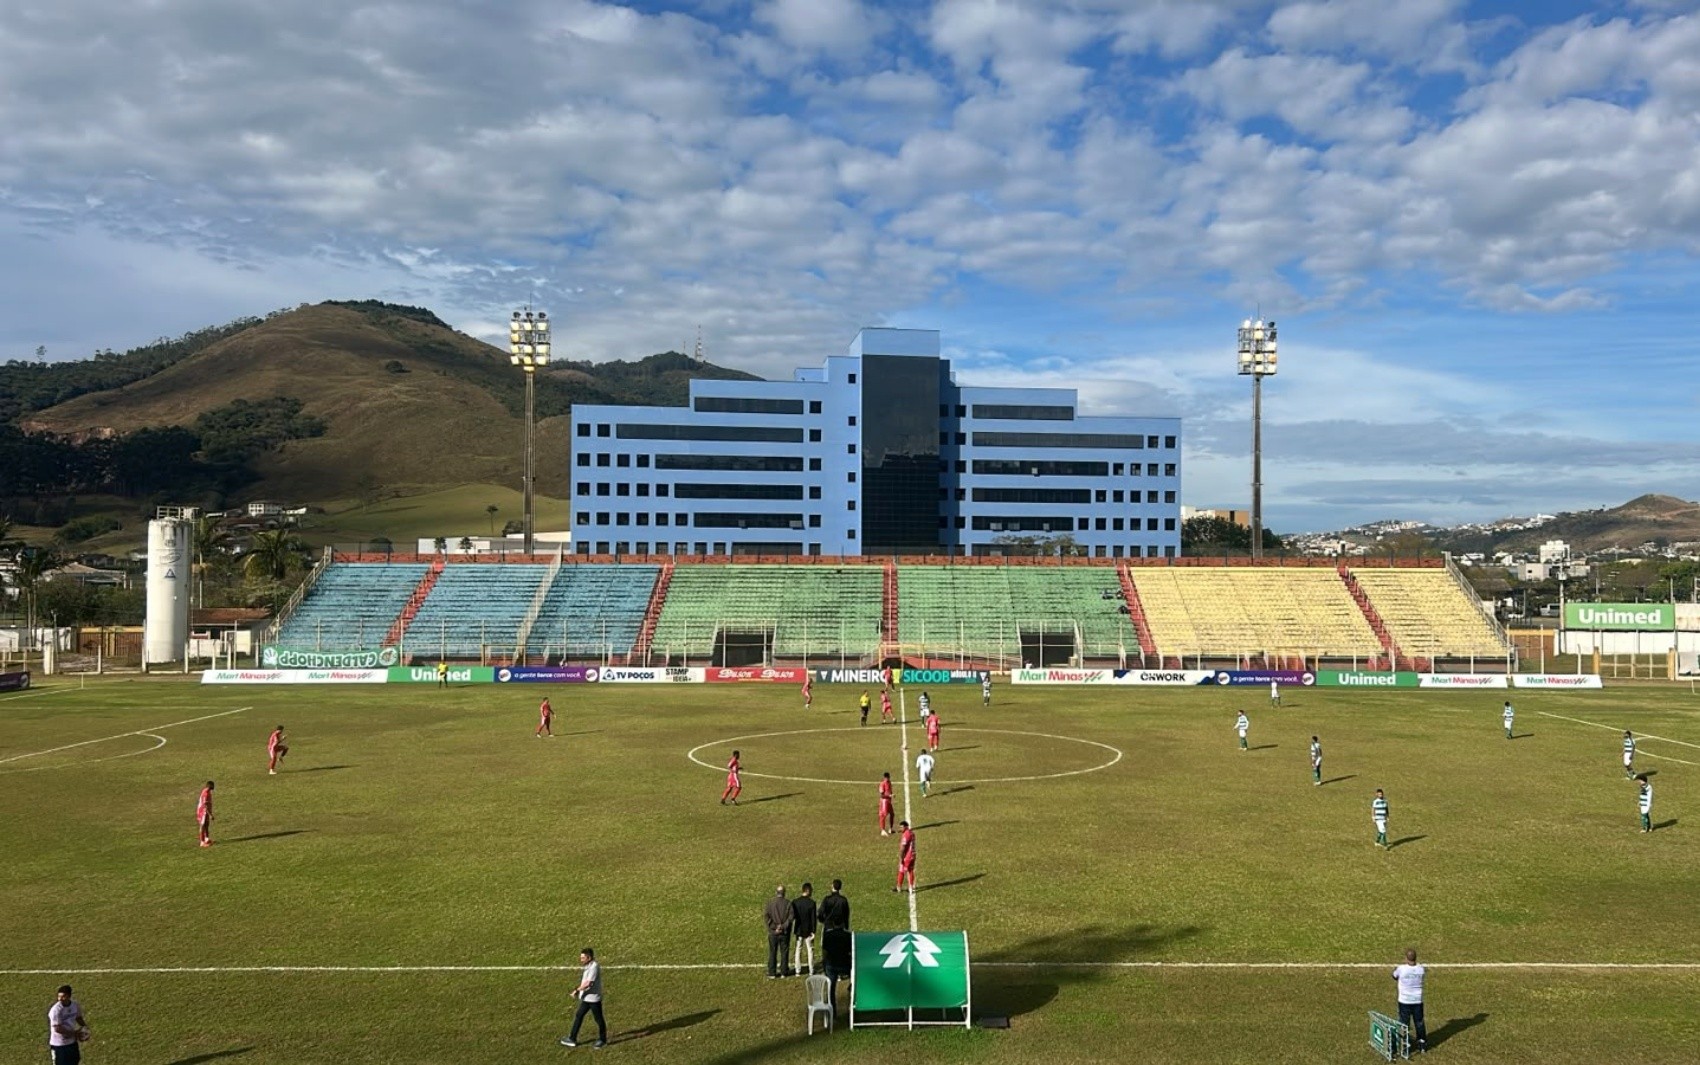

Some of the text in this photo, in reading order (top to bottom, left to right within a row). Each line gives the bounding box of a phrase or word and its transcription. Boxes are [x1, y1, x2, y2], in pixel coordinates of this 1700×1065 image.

[1579, 608, 1661, 624] Unimed
[279, 651, 377, 668] CALDENCHOPP
[616, 671, 655, 681] TV POÇOS
[903, 670, 950, 683] SICOOB
[1019, 671, 1084, 681] Mart Minas
[1338, 673, 1396, 685] Unimed
